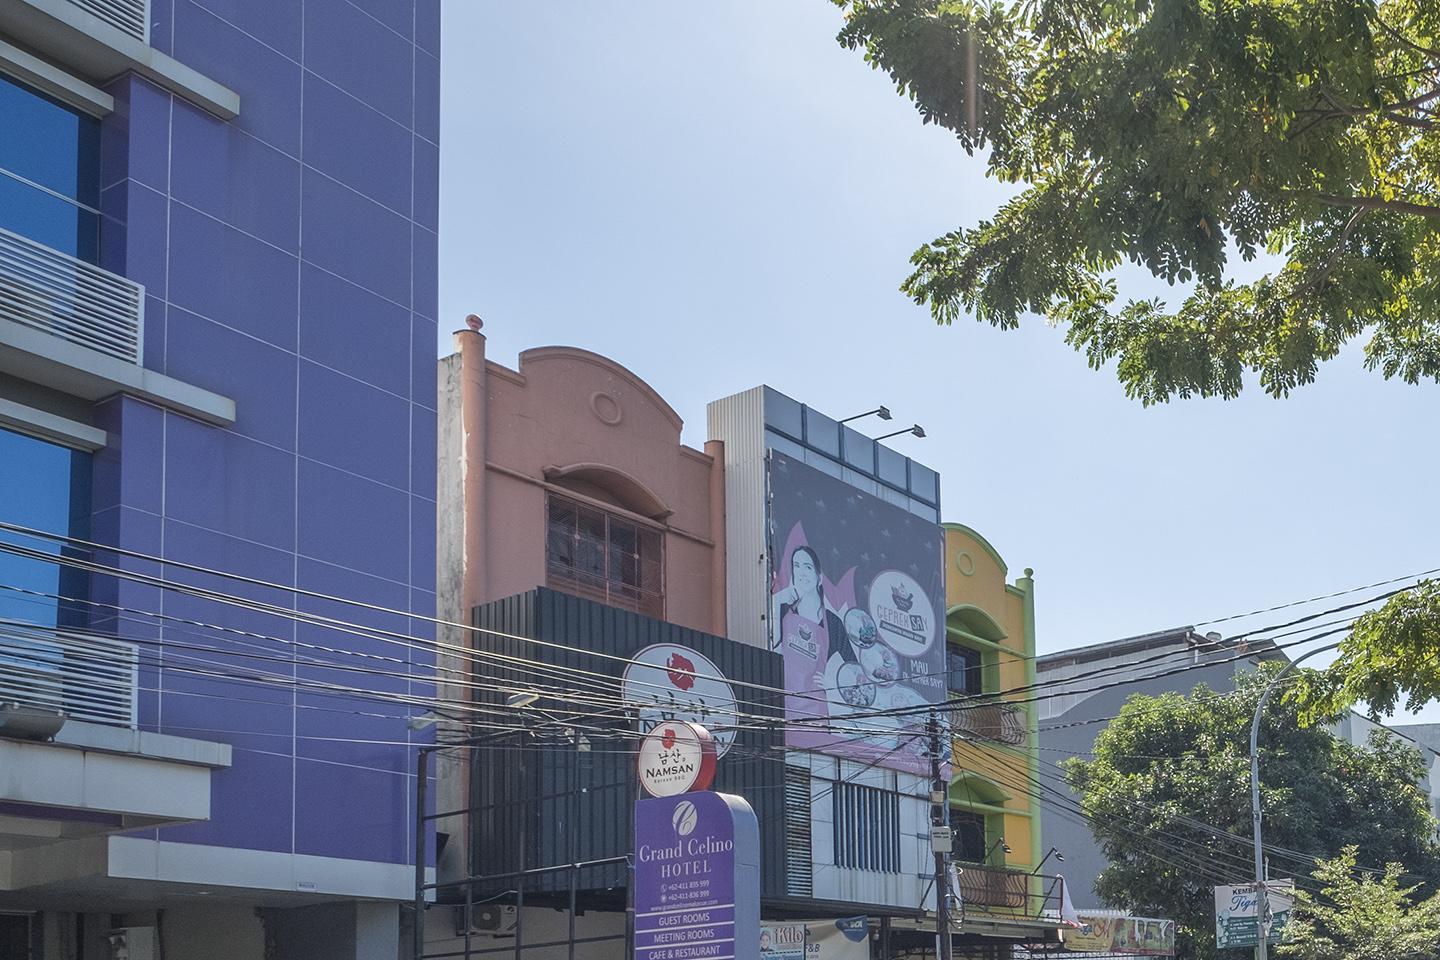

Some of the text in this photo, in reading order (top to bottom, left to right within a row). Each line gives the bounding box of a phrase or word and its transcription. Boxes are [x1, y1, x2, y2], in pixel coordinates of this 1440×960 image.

[646, 763, 694, 779] NAMSAN
[640, 836, 733, 863] Grand Celino
[661, 860, 712, 878] HOTEL
[658, 912, 710, 926] GUEST ROOMS
[654, 929, 714, 943] MEETING ROOMS
[649, 945, 720, 960] CAFE & RESTAURANT
